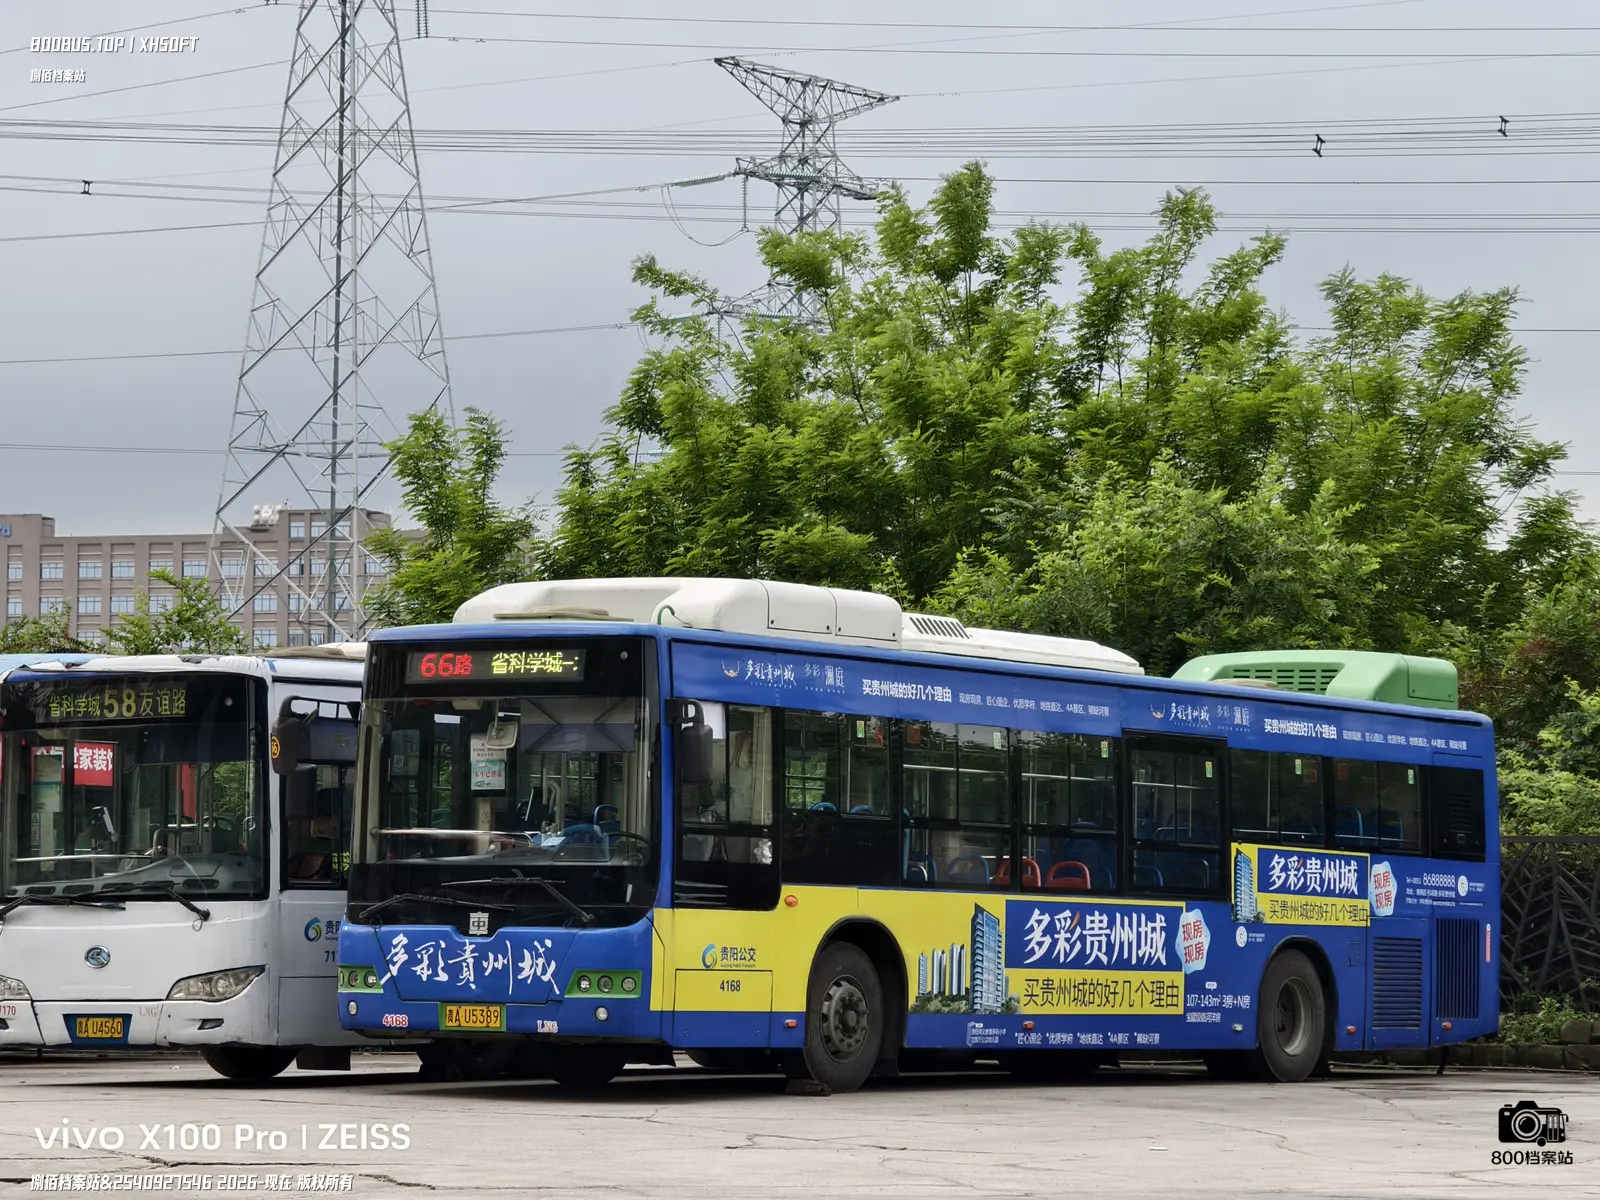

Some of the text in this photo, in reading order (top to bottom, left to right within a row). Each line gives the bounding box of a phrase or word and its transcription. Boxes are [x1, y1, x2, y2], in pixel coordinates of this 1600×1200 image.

[420, 652, 472, 678] 66路
[862, 679, 952, 703] 买贵州城的好几个理由
[1264, 718, 1337, 740] 买贵州城的好几个理由
[1268, 854, 1359, 896] 多彩贵州城
[1373, 870, 1391, 891] 现房
[1423, 872, 1456, 888] 86888888
[1375, 889, 1393, 910] 现房
[1268, 899, 1368, 923] 买贵州城的好几个理由
[1023, 908, 1167, 966] 多彩贵州城
[1182, 919, 1202, 942] 现房
[324, 950, 338, 962] 71
[720, 946, 756, 962] 贵阳公交
[1184, 941, 1204, 964] 现房
[719, 980, 741, 992] 4168
[1023, 977, 1180, 1008] 买贵州城的好几个理由
[382, 1014, 409, 1027] 4168
[537, 1020, 558, 1034] LNG
